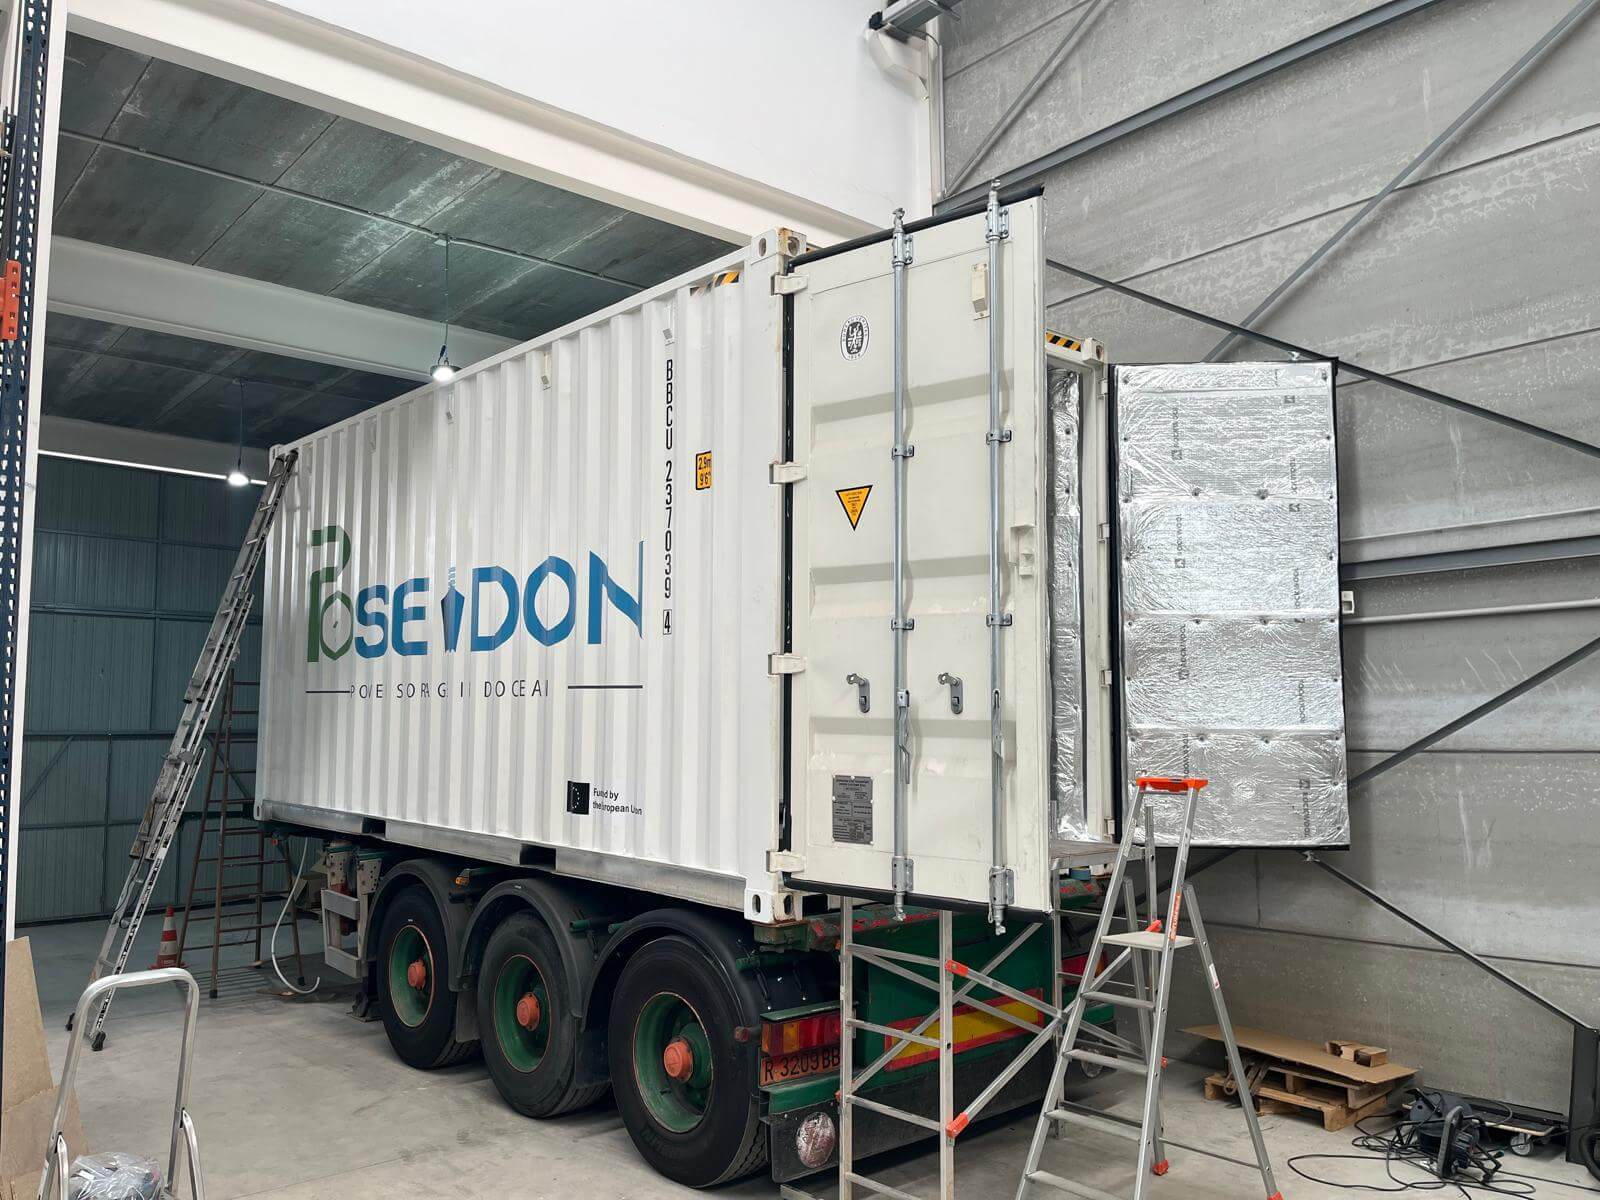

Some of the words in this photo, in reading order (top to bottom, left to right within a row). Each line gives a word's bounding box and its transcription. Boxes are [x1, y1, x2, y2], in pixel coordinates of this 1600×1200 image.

[665, 359, 673, 450] BBCU
[664, 460, 673, 599] 237039
[663, 610, 672, 634] 4
[609, 790, 619, 801] by
[765, 1061, 774, 1082] R
[780, 1052, 819, 1077] 3209
